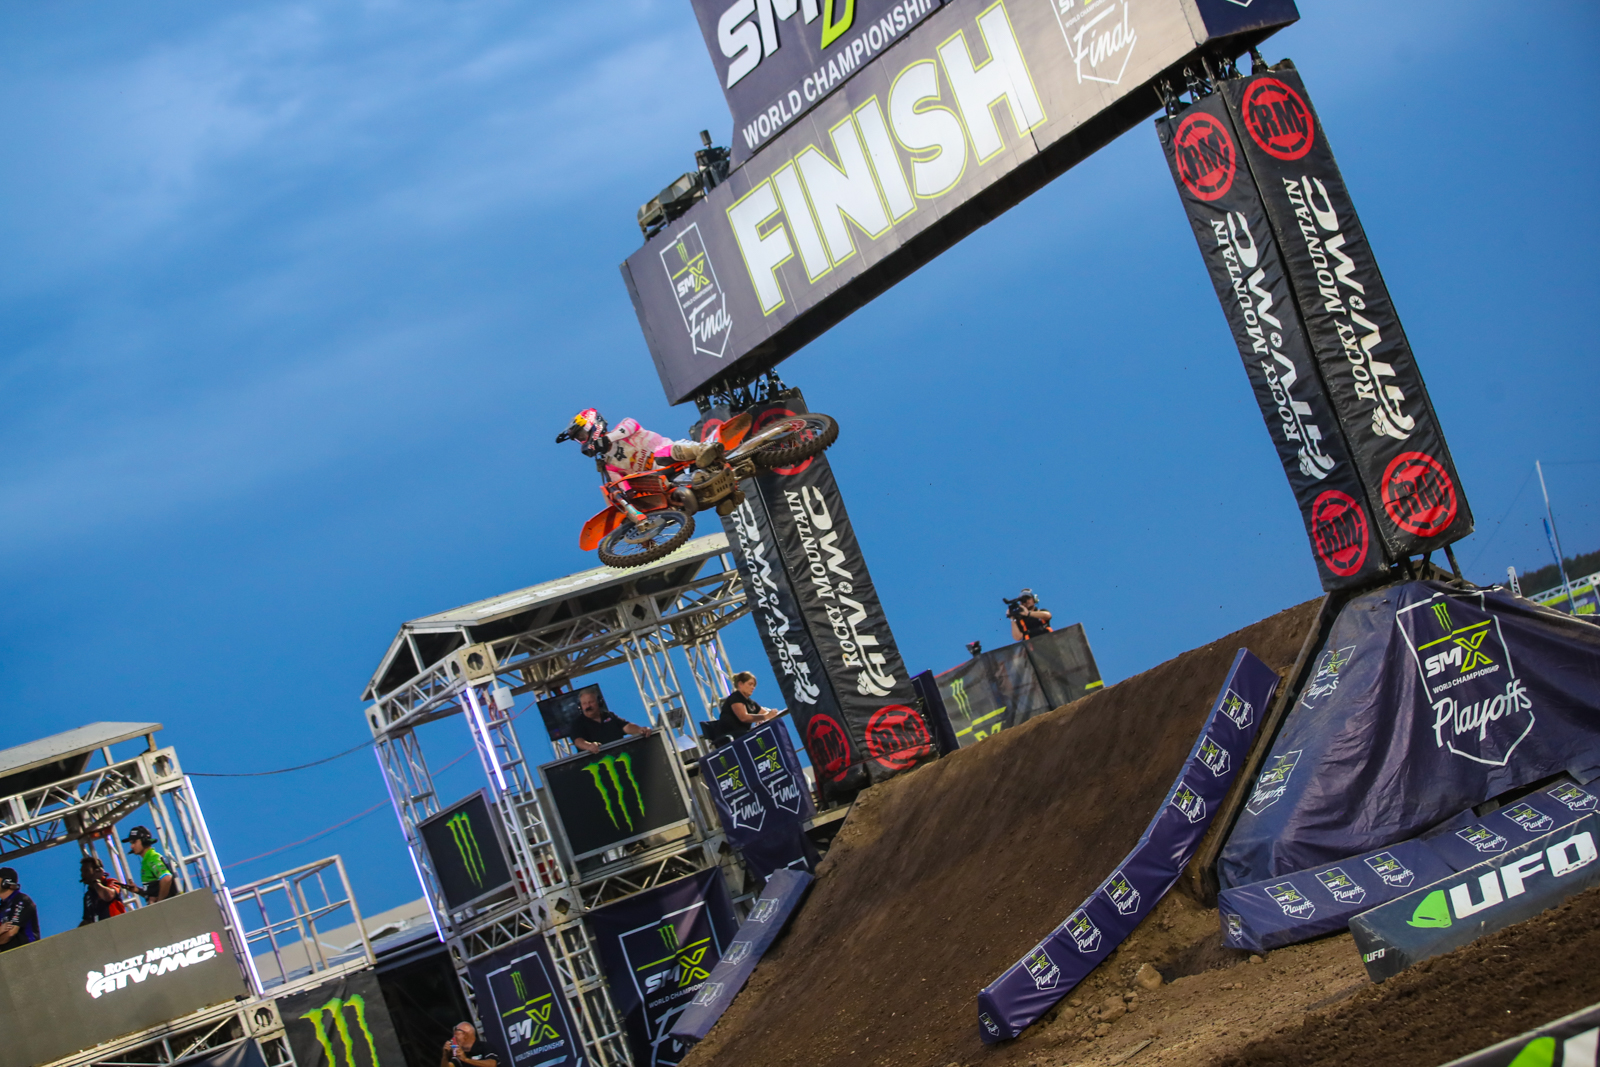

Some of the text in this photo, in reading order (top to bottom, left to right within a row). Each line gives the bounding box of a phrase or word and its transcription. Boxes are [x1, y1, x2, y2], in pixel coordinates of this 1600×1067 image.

[1073, 1, 1135, 84] Final
[743, 0, 932, 149] WORLD CHAMPIONSHI
[726, 0, 1047, 317] FINISH
[677, 259, 710, 297] SMX
[1282, 177, 1378, 402] ROCKY MOUNTAIN
[689, 292, 730, 355] Final
[1211, 219, 1302, 442] ROCKY MOUNTAIN
[731, 509, 797, 676] ROCKY MOUNTAI
[784, 490, 862, 668] ROCKY MOUNTAIN
[1425, 629, 1493, 678] SMX
[1432, 664, 1500, 694] WORLD CHAMPIONSHIP
[1432, 679, 1532, 748] Playoffs
[720, 770, 744, 791] SMX
[757, 751, 781, 773] SMX
[730, 792, 764, 829] Final
[768, 774, 800, 809] Final
[1333, 885, 1365, 901] Playoffs
[1382, 869, 1414, 885] Playoffs
[1449, 831, 1598, 919] UFO
[1281, 900, 1315, 916] Playoffs
[104, 954, 144, 976] ROCKY
[146, 932, 211, 962] MOUNTAIN
[645, 946, 711, 994] SMX
[1366, 947, 1386, 963] UFO
[649, 996, 670, 1008] WORLD
[670, 982, 705, 1000] CHAMPION
[508, 1002, 560, 1047] SMX
